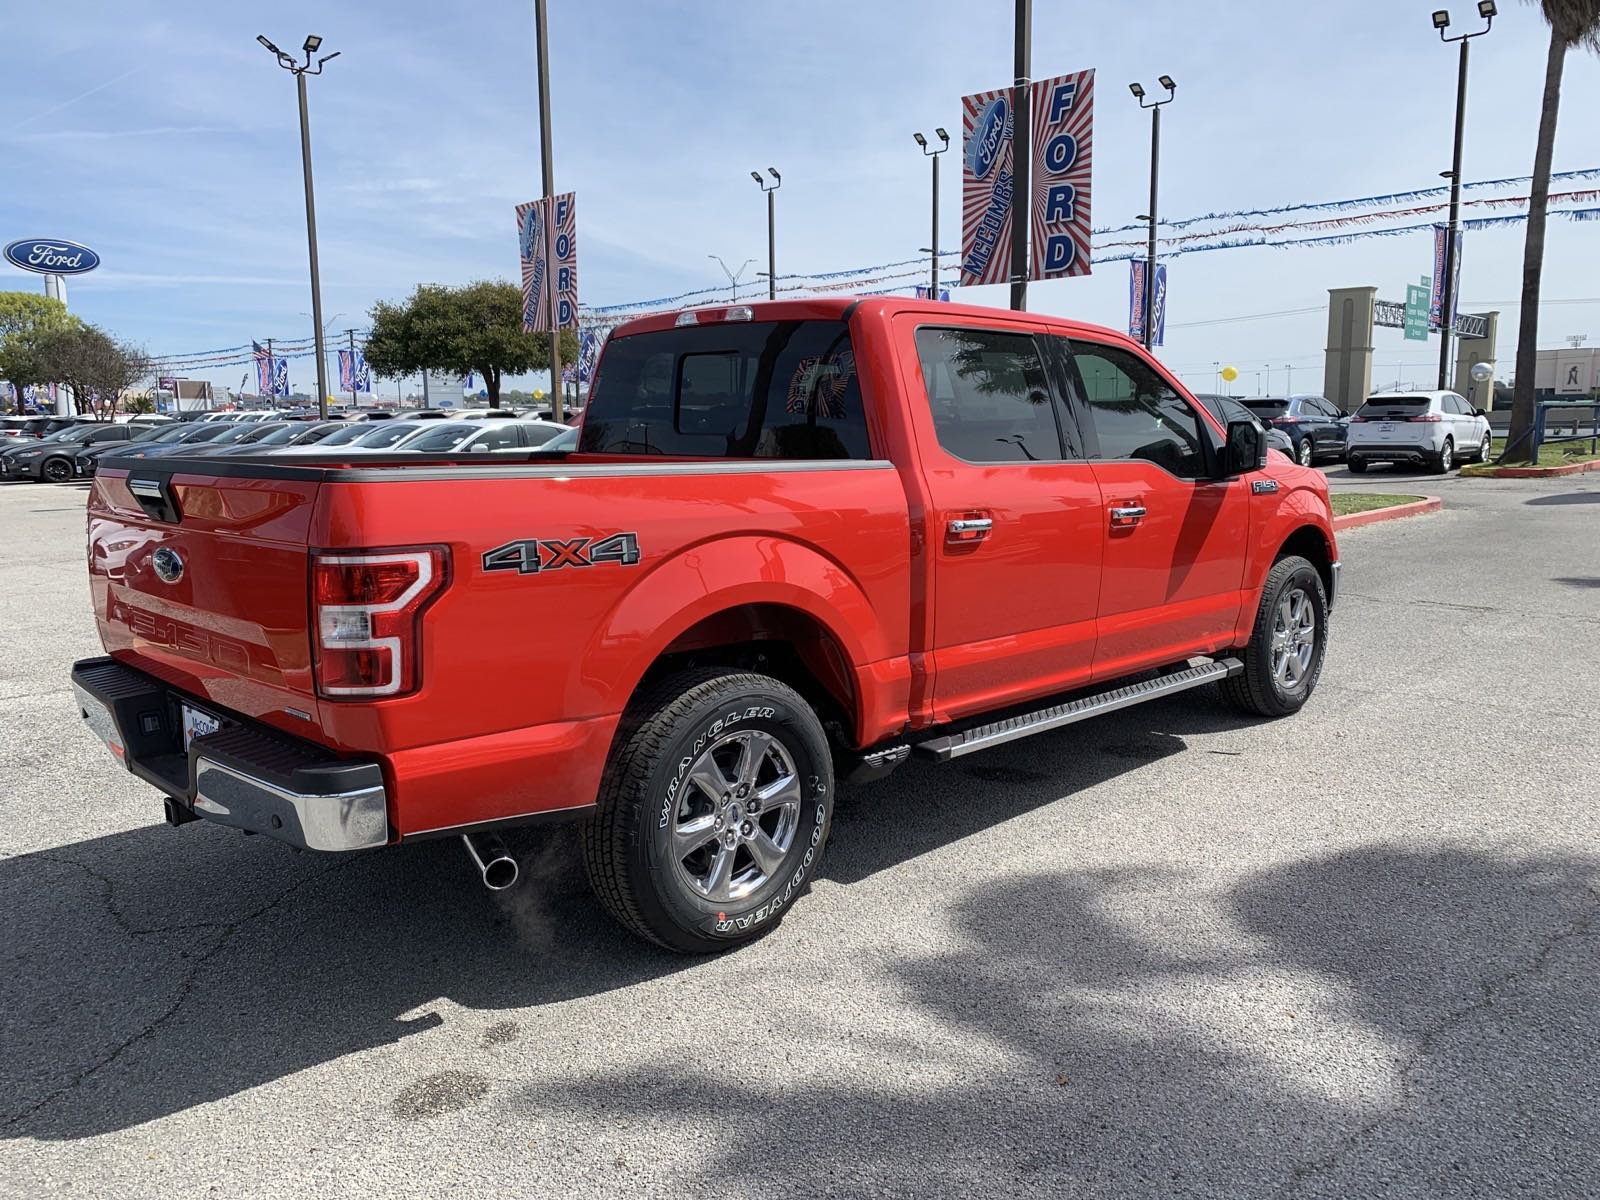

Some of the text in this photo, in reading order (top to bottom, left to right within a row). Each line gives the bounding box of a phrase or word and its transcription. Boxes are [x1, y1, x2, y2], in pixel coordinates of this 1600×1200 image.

[978, 113, 1003, 165] Ford
[1044, 82, 1078, 273] FORD
[28, 244, 82, 268] Ford
[554, 200, 572, 326] FORD
[275, 366, 288, 390] Ford
[579, 341, 596, 375] Ford
[658, 707, 775, 829] WRANGLER
[716, 803, 826, 932] GOODYEAR
